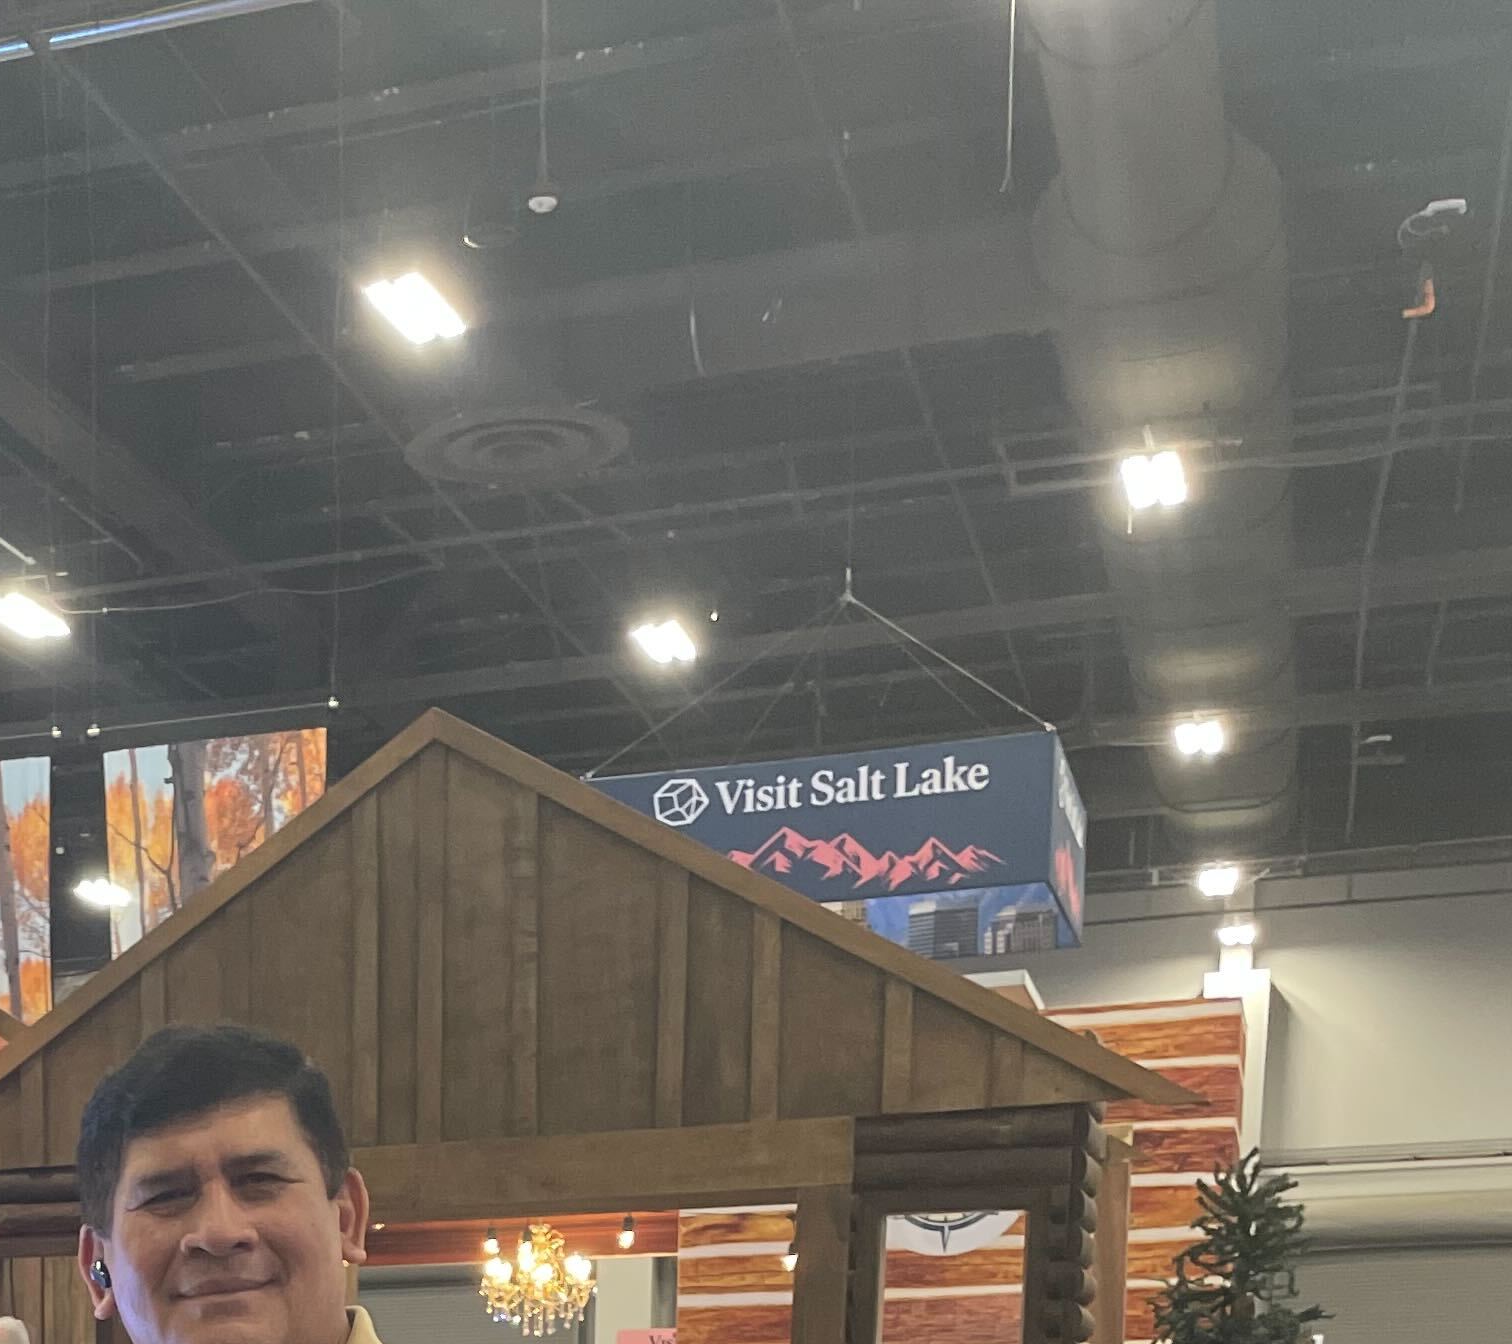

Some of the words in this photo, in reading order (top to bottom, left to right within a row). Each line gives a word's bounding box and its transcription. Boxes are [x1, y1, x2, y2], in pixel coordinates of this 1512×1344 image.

[715, 775, 803, 815] Visit
[810, 765, 886, 807] Salt
[893, 756, 989, 798] Lake
